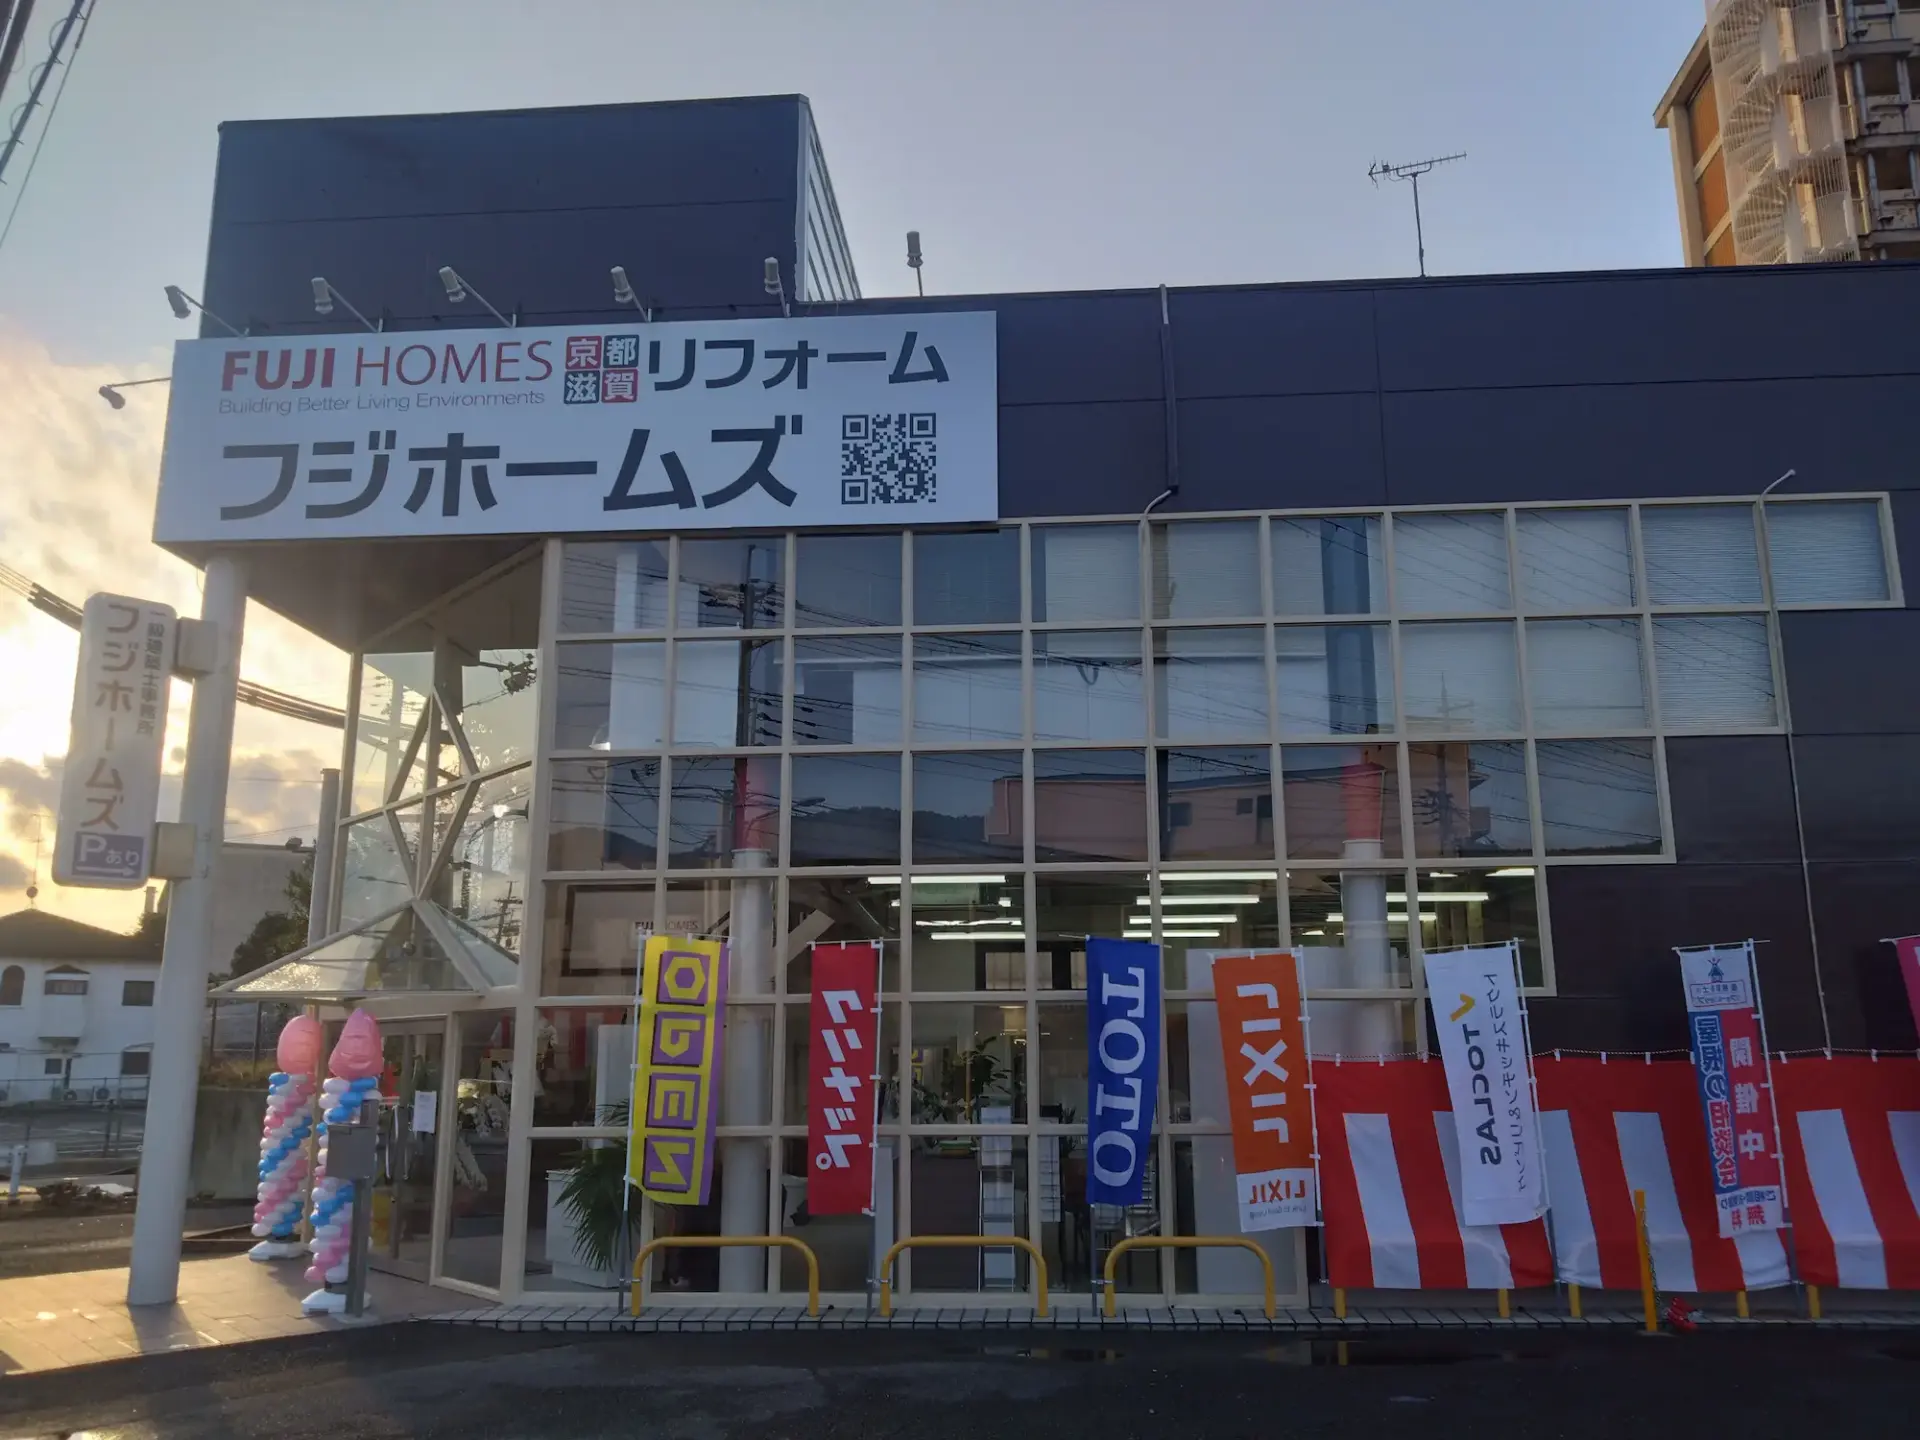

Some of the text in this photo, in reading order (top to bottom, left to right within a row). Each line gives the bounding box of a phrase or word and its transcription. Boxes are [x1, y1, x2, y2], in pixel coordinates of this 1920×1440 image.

[221, 340, 553, 391] FUJI HOMES
[567, 336, 638, 368] 京都
[648, 331, 950, 391] リフォーム
[218, 390, 546, 416] Building Better Living Environments
[565, 370, 636, 402] 滋賀
[220, 415, 803, 520] フジホームズ
[80, 603, 140, 831] フジホームズ
[78, 834, 140, 866] Pあり
[1093, 966, 1146, 1187] TOTO
